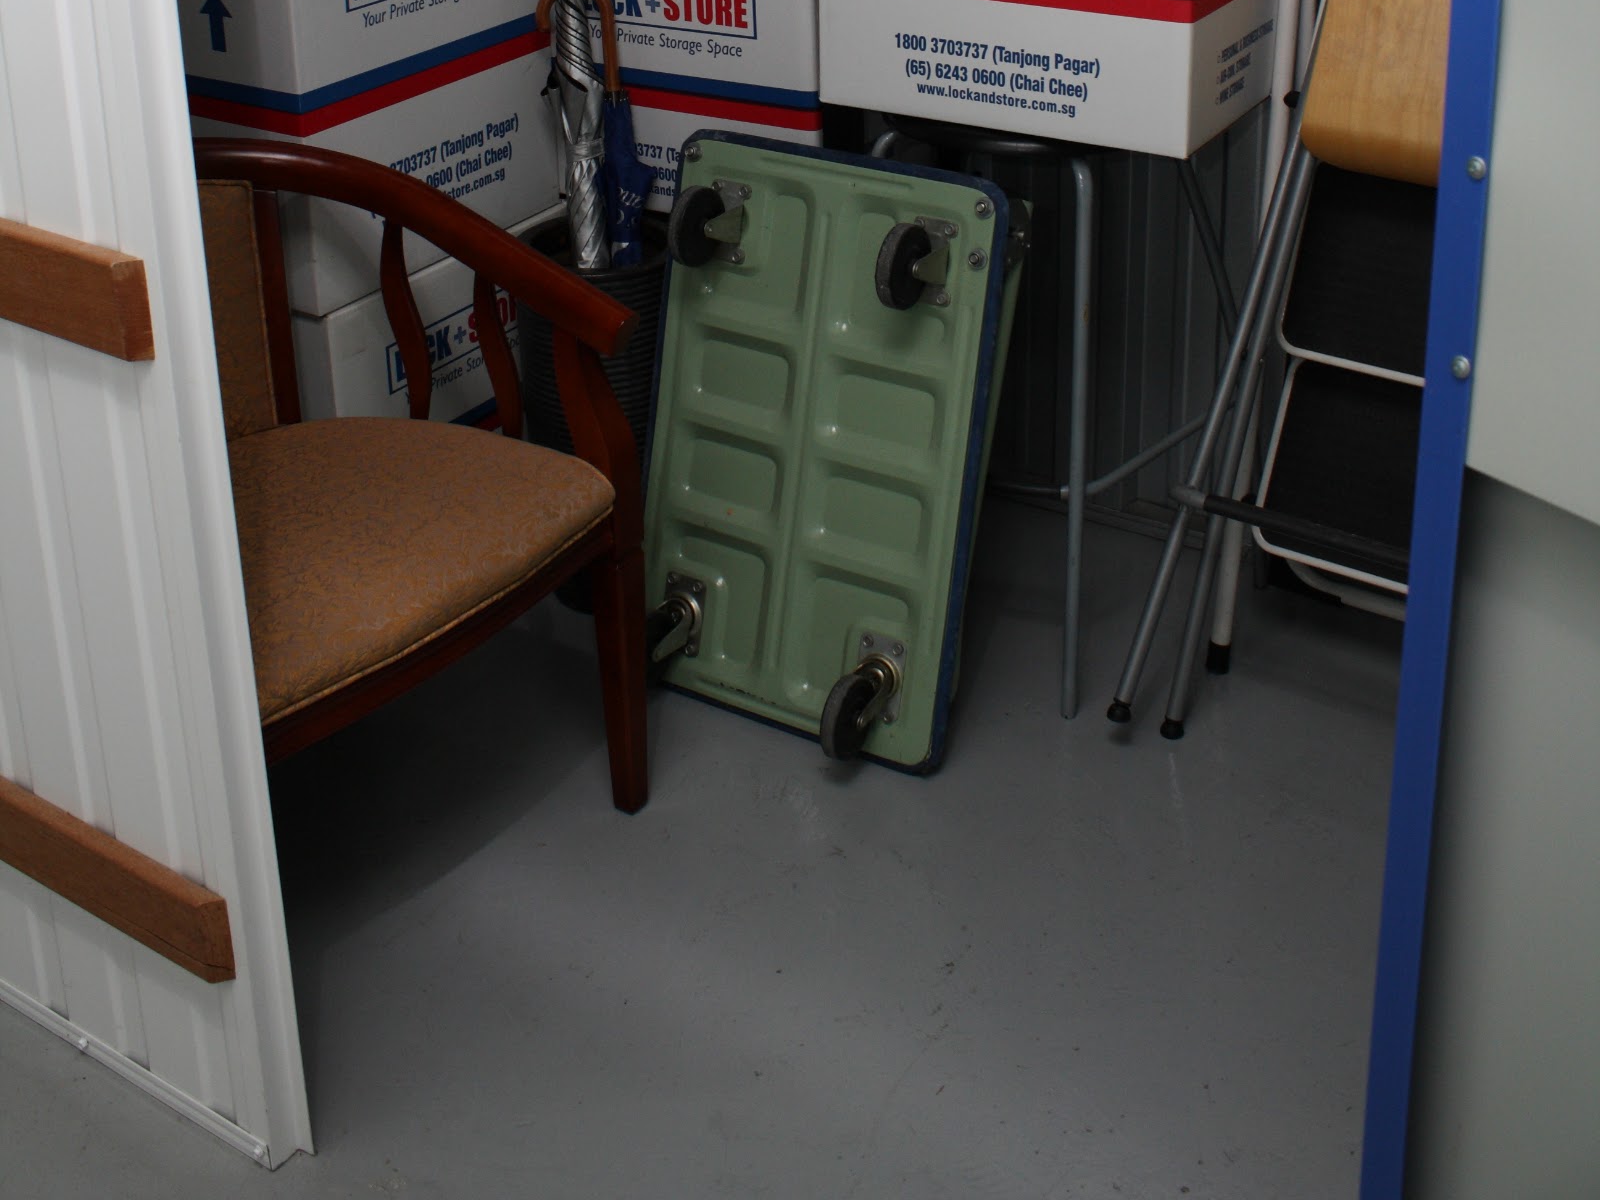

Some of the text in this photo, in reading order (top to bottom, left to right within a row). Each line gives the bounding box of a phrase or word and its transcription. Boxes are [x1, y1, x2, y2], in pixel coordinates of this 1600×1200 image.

[362, 11, 386, 28] Your
[617, 28, 655, 46] Private
[659, 33, 702, 55] Storage
[707, 39, 742, 58] Space
[894, 32, 1101, 79] 1800 3703737 (Tanjong Pagar)
[905, 58, 1088, 103] (65) 6243 0600 (Chai Chee)
[917, 82, 1076, 118] www.lockandstore.com.sg
[441, 130, 483, 162] (Tanjong
[486, 112, 519, 140] Pagar)
[637, 142, 663, 159] 3737
[456, 153, 482, 182] (Chai
[484, 141, 512, 167] Chee)
